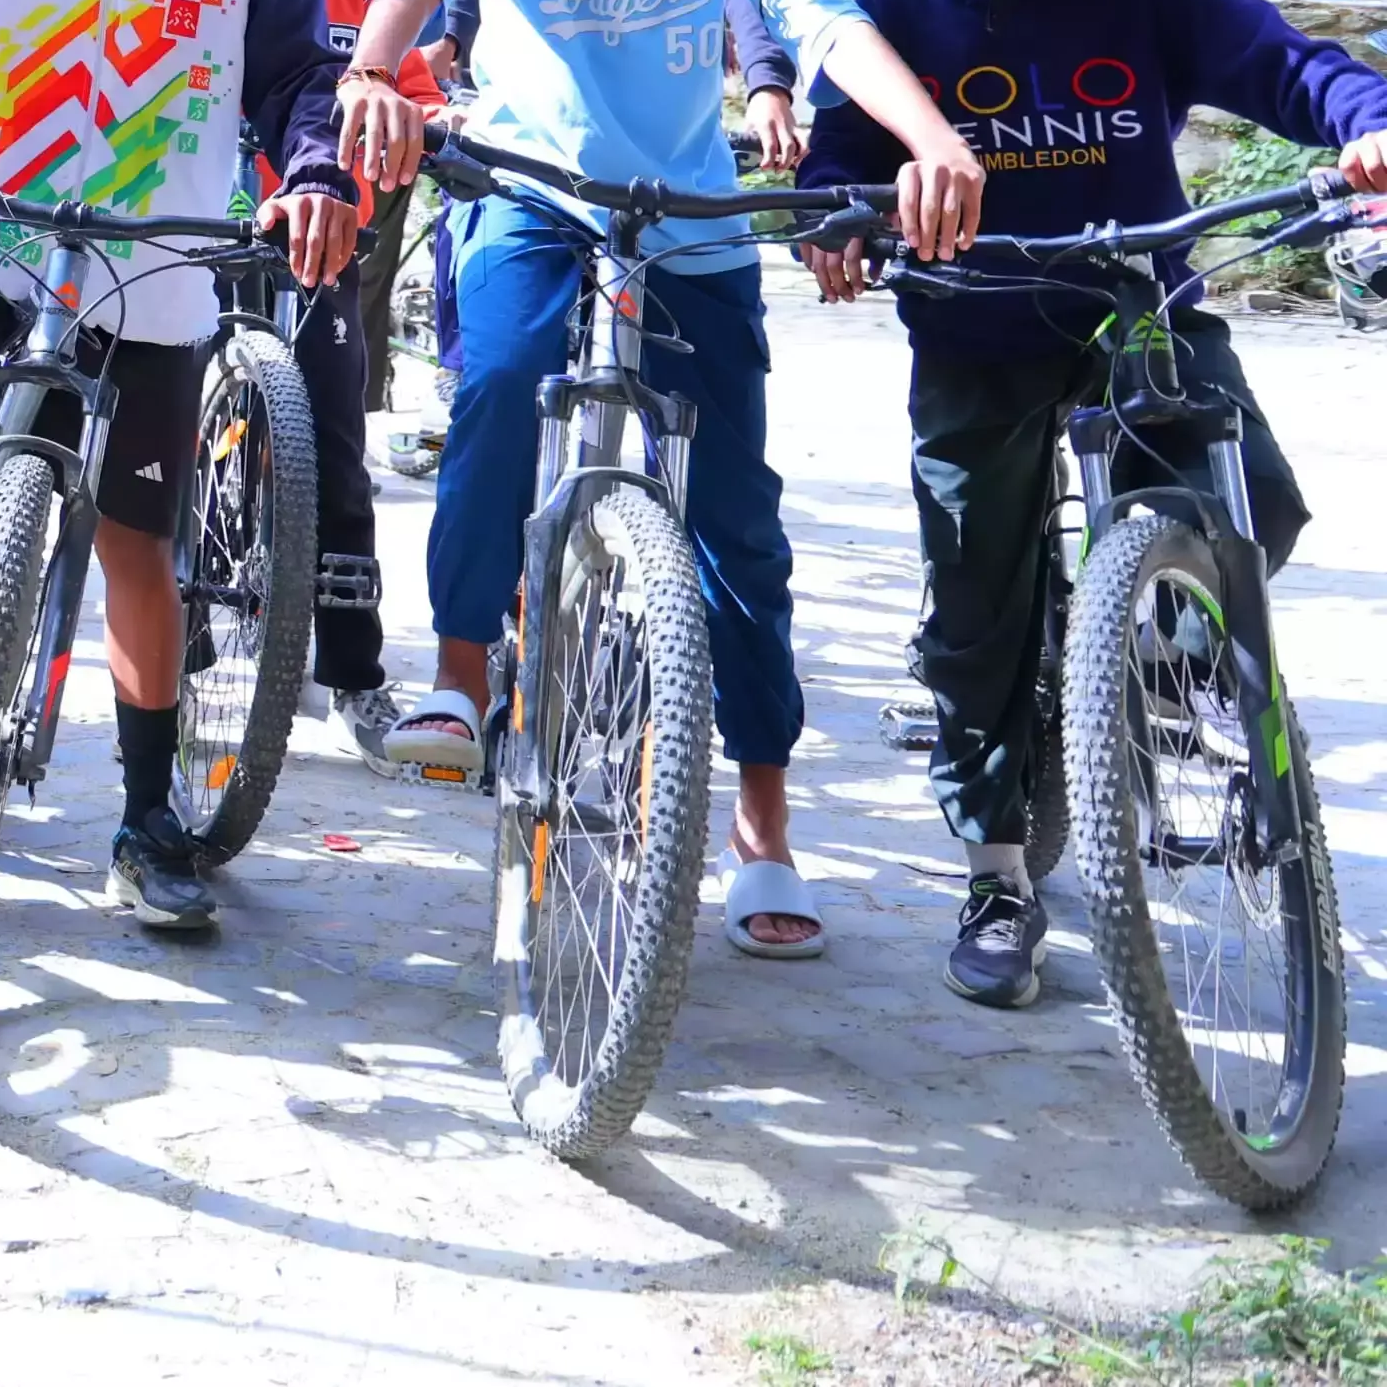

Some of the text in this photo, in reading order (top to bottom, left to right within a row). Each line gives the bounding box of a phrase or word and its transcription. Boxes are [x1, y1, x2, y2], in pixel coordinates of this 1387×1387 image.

[665, 20, 724, 75] 50
[954, 109, 1143, 151] ENNIS
[979, 146, 1107, 172] IMBLEDON
[1304, 820, 1338, 978] MERIDA
